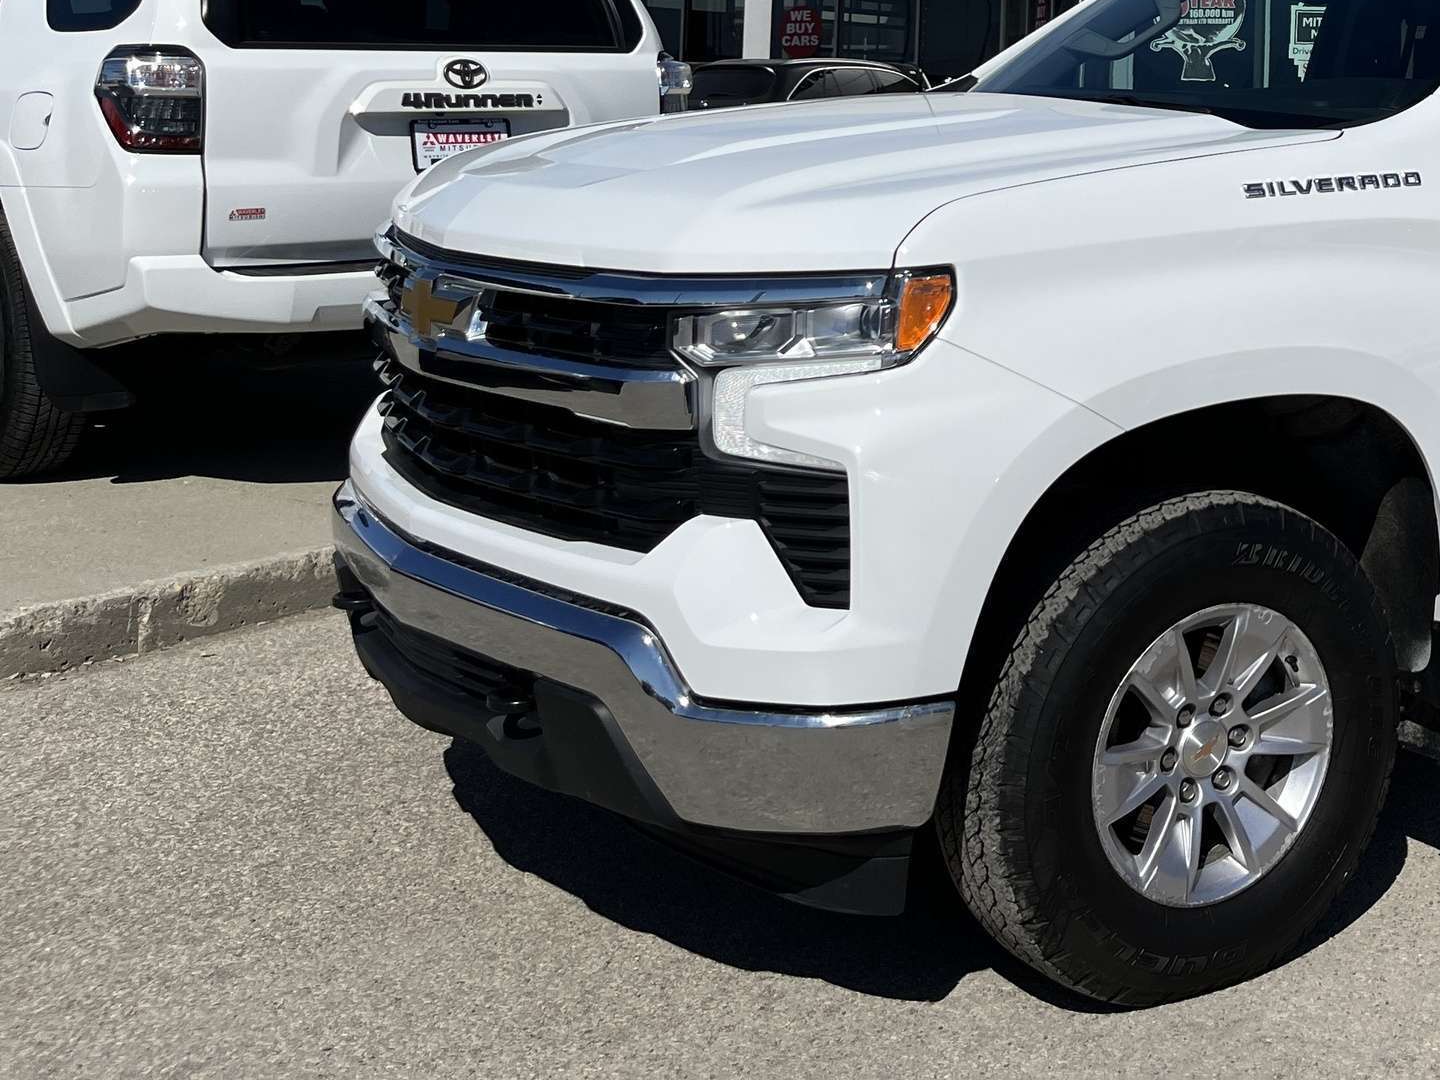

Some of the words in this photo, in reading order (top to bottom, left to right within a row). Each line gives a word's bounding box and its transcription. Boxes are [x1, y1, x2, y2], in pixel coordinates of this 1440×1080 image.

[790, 9, 812, 22] WE
[1221, 8, 1235, 18] km
[786, 22, 815, 34] BUY
[782, 35, 819, 47] CARS
[438, 133, 501, 145] WAVERLEY
[1243, 171, 1423, 199] SILVERADO
